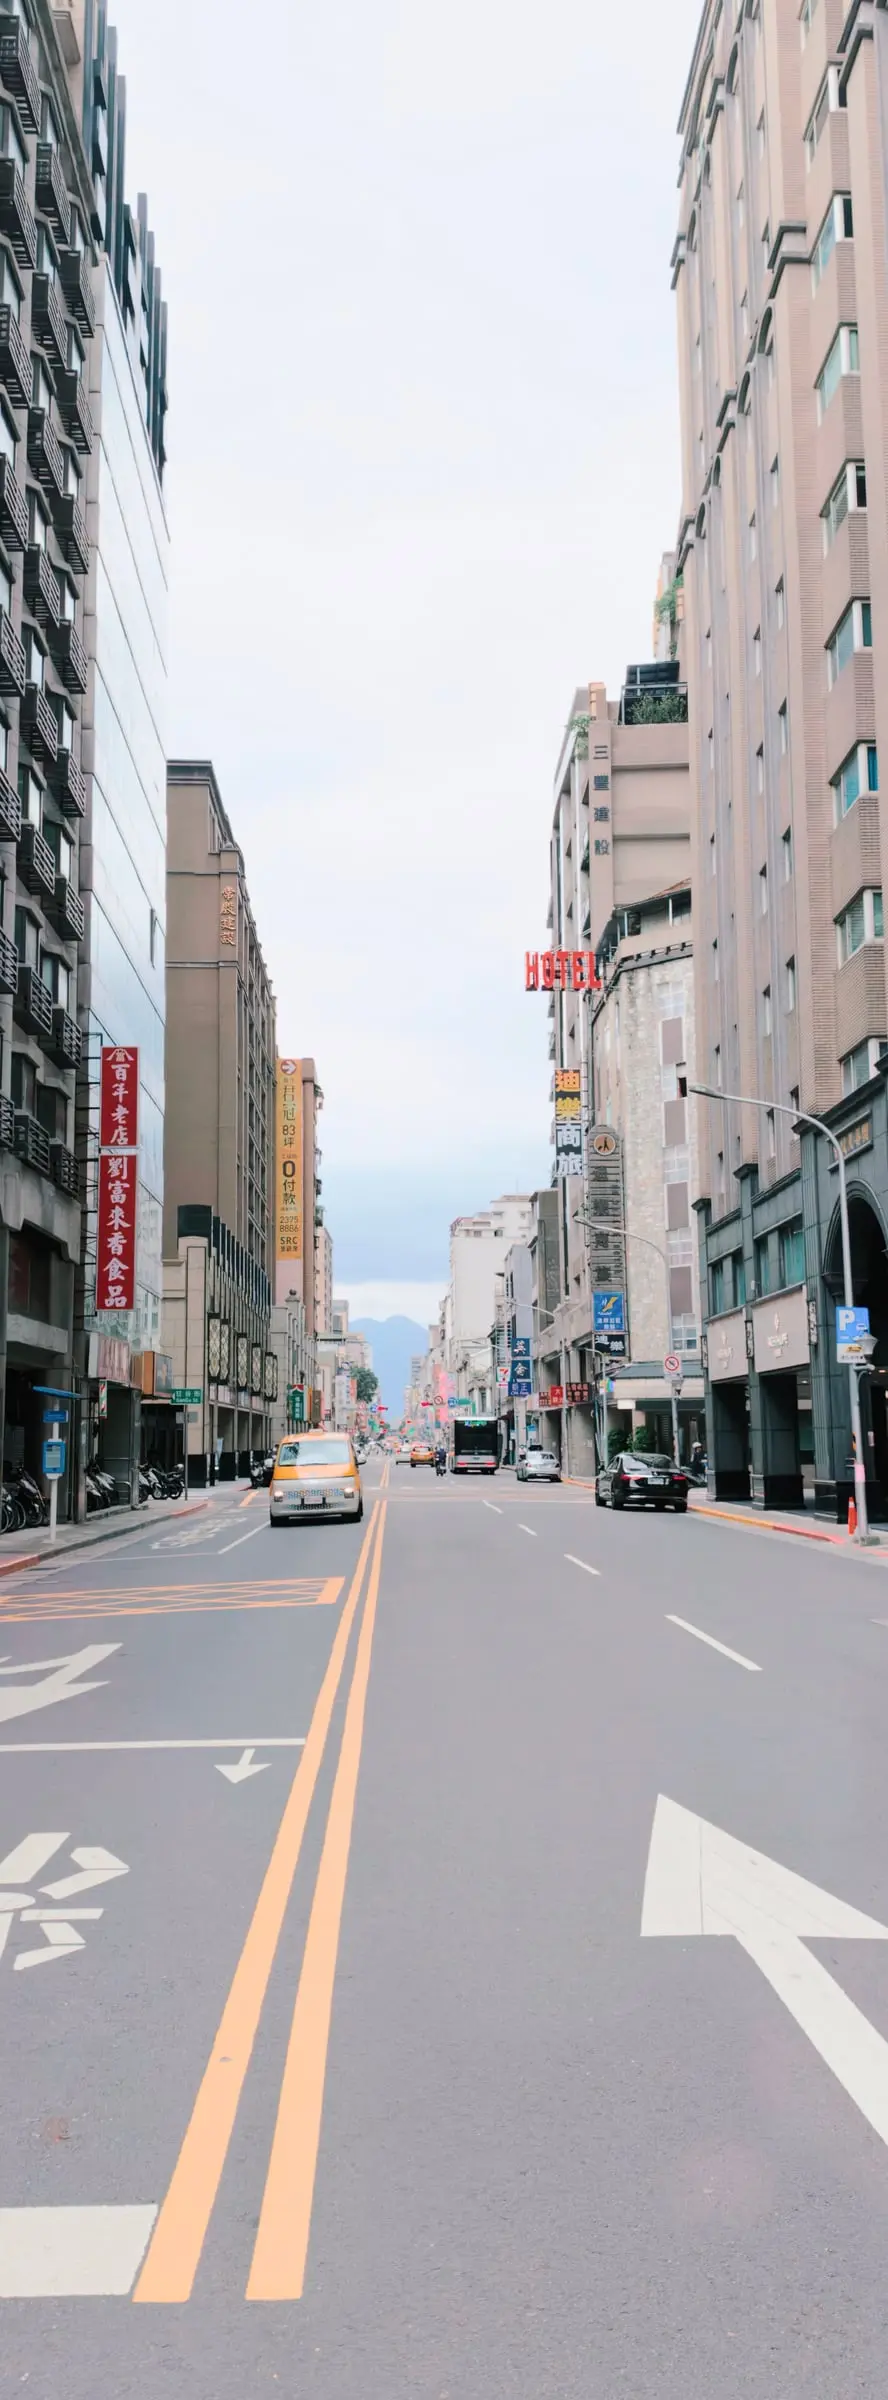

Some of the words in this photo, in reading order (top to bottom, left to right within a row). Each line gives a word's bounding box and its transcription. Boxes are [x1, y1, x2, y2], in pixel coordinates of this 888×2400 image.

[525, 951, 602, 991] HOTEL
[110, 1063, 129, 1146] 百年老店
[103, 1157, 131, 1308] 劉富來香食品
[280, 1236, 298, 1245] SRC
[839, 1310, 855, 1331] P
